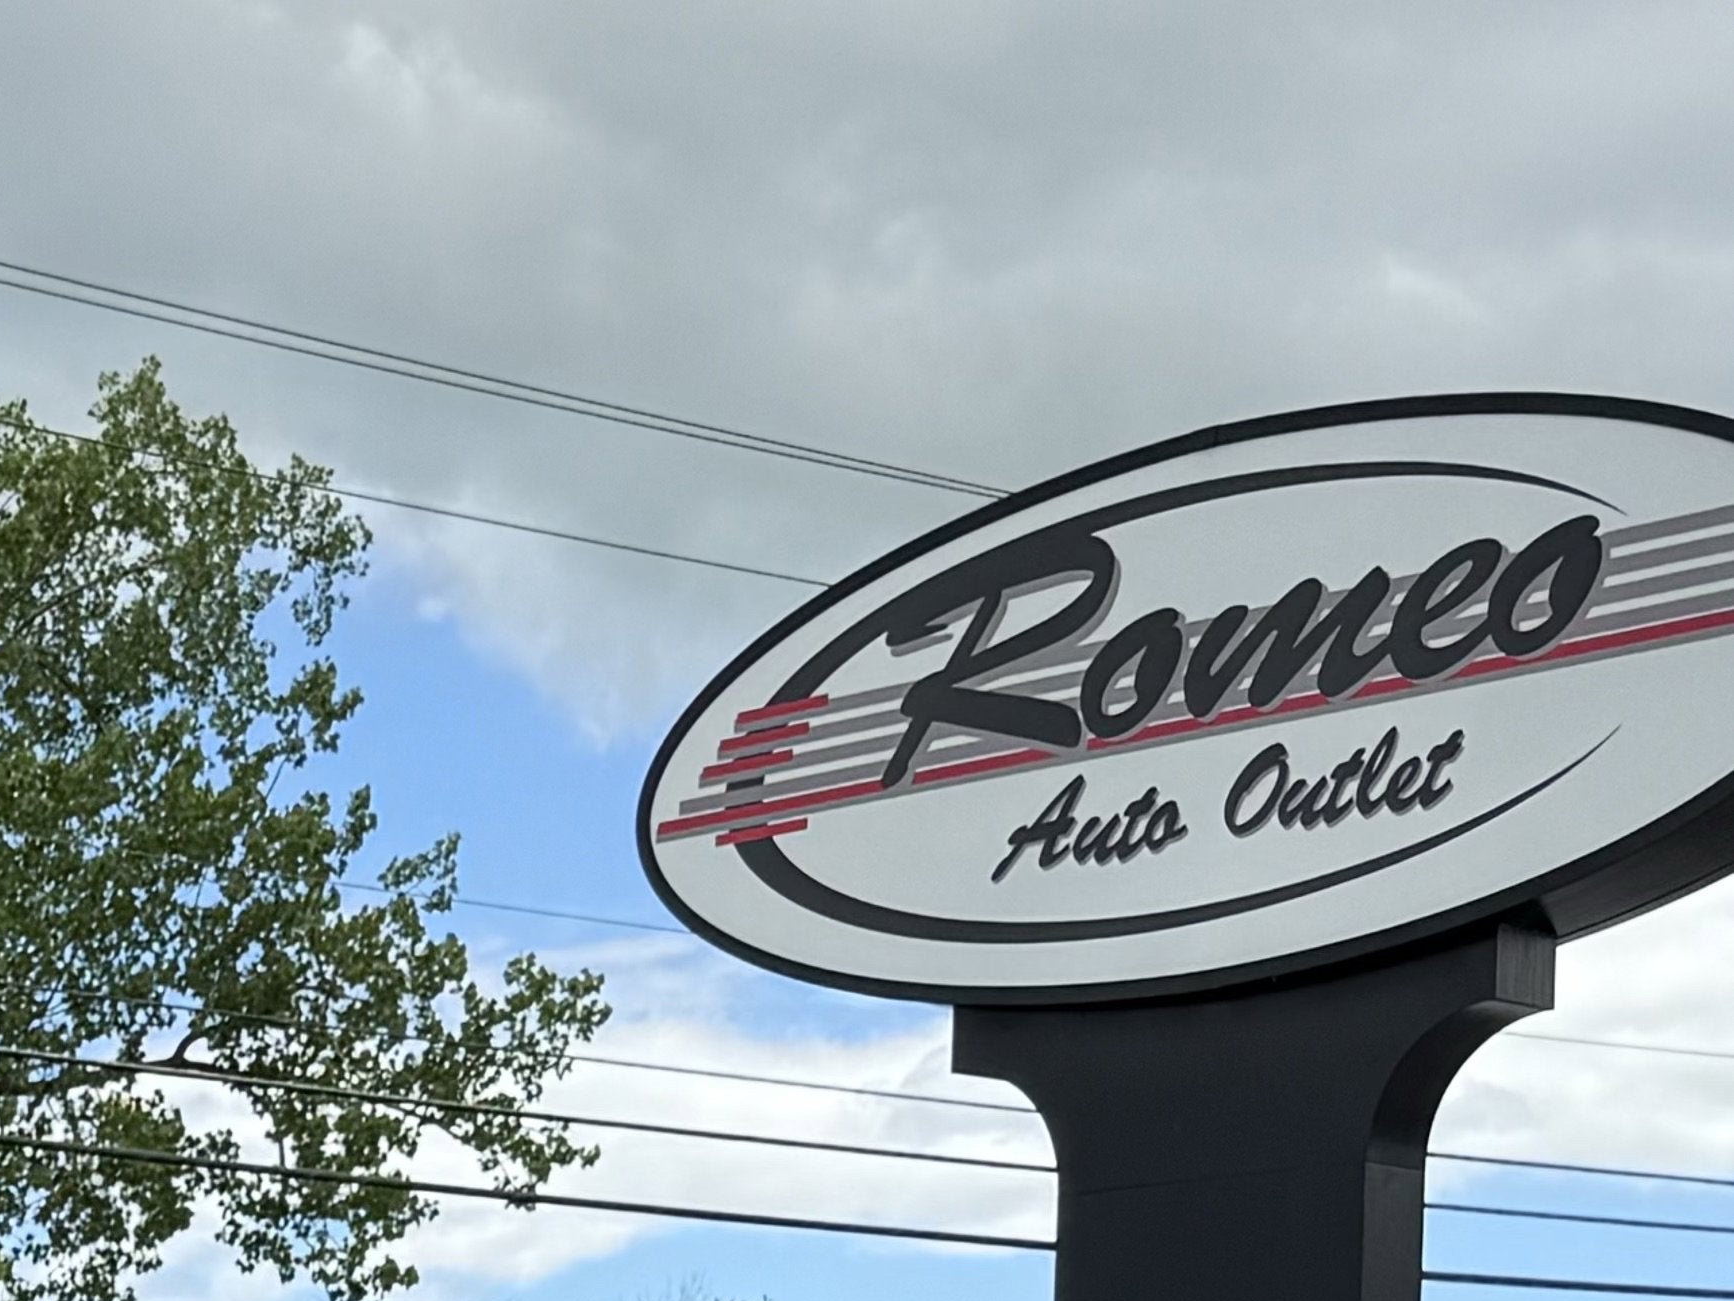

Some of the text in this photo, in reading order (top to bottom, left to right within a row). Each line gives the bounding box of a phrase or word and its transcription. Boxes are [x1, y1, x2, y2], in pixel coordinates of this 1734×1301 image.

[882, 514, 1601, 789] Romeo
[991, 725, 1464, 883] Auto Outlet
